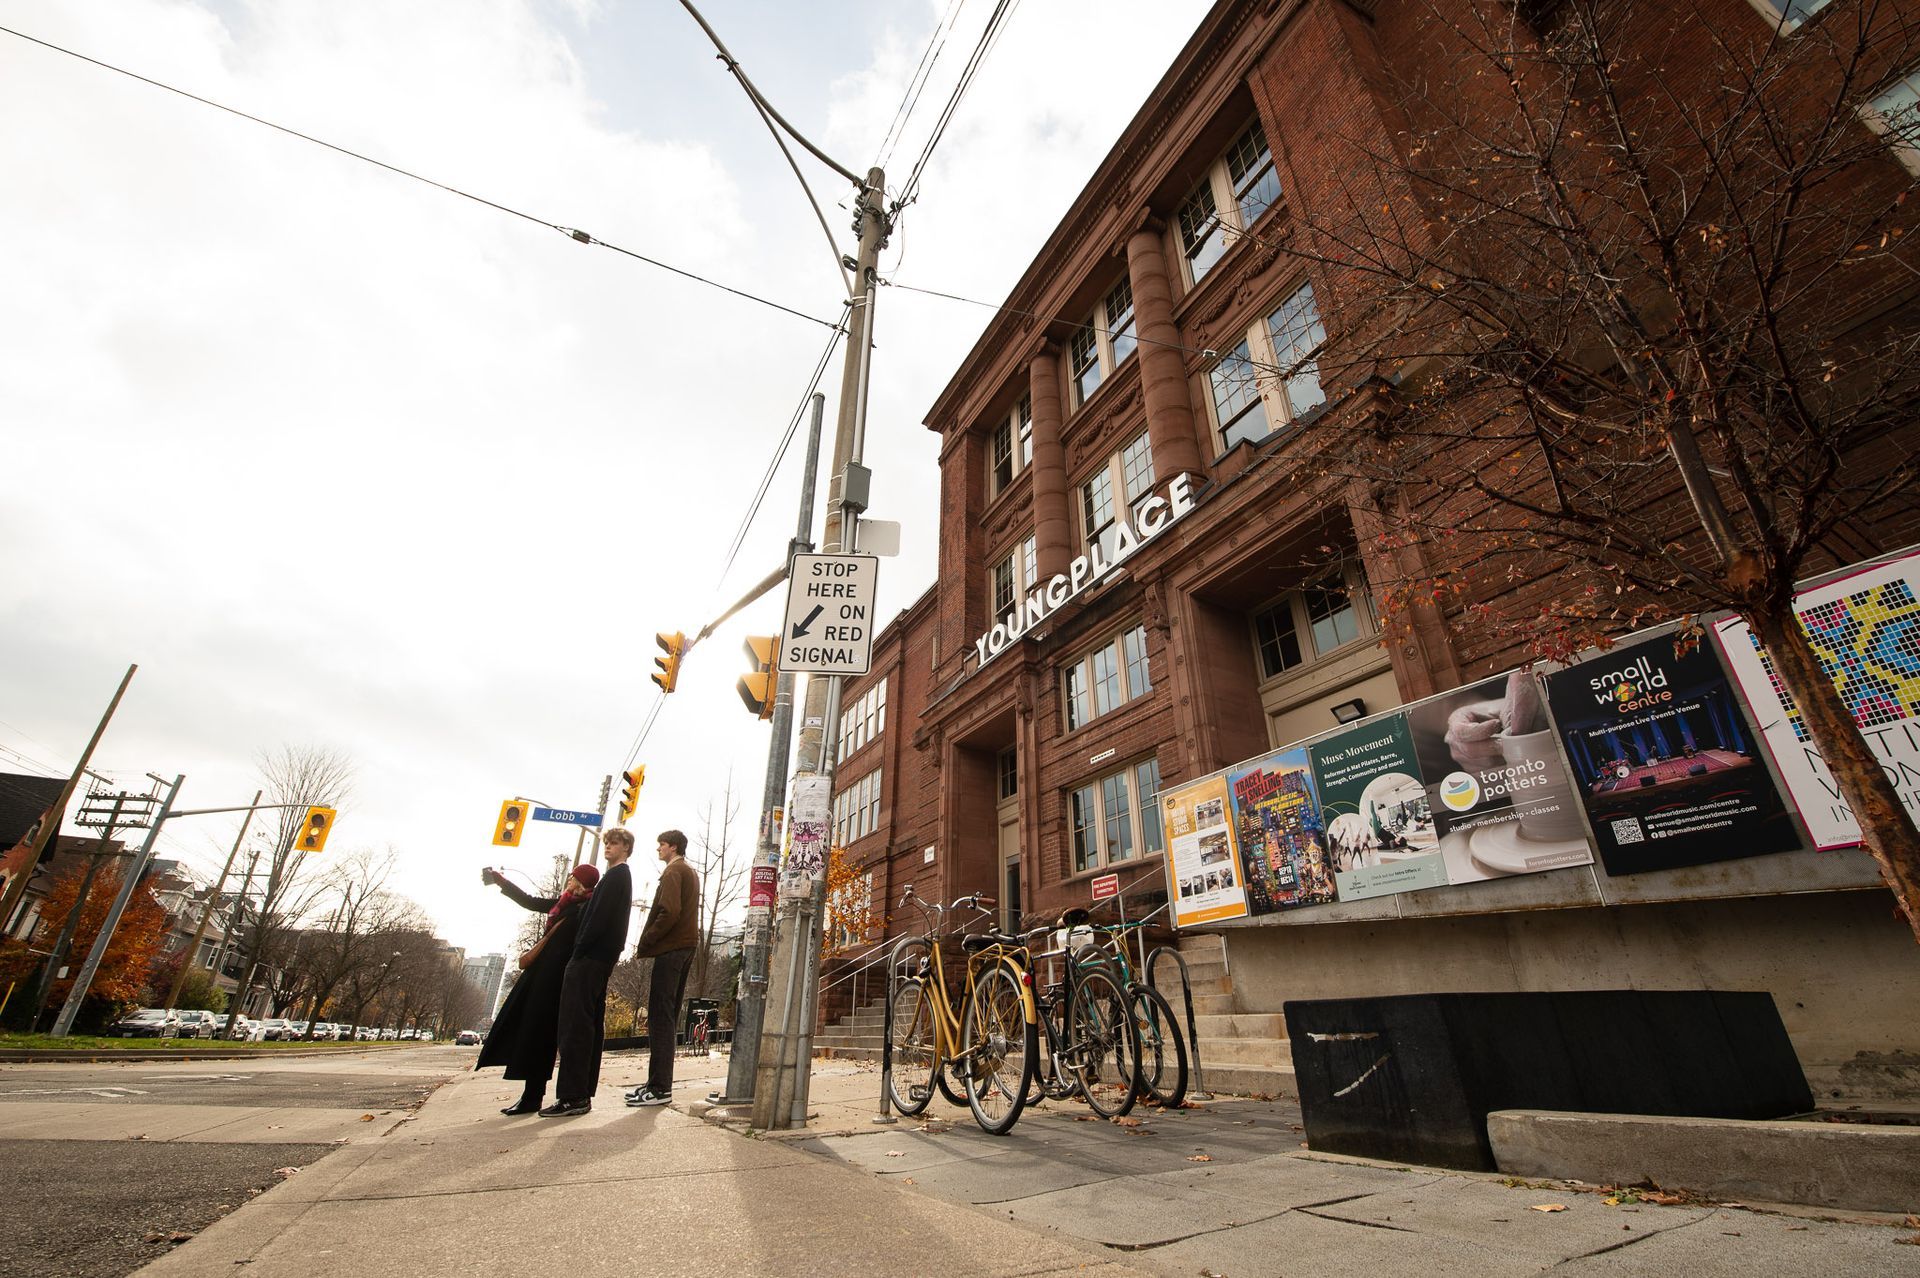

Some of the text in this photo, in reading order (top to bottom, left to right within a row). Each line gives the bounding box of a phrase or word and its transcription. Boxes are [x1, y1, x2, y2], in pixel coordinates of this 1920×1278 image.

[812, 562, 858, 577] STOP
[976, 472, 1196, 667] YOUNGPLACE
[807, 583, 857, 598] HERE
[840, 605, 865, 620] ON
[825, 626, 863, 641] RED
[789, 647, 853, 664] SIGNAL
[1590, 656, 1651, 690] small
[1618, 690, 1673, 713] centre
[1589, 703, 1700, 738] Multi-purpose Live Events Venue
[1321, 734, 1394, 767] Muse Movement
[1324, 768, 1346, 779] Reformer
[1348, 767, 1377, 781] Community
[1377, 763, 1388, 771] and
[1388, 758, 1405, 768] more!
[1480, 759, 1546, 784] toronto
[1236, 771, 1261, 795] TRACEY
[1248, 774, 1280, 801] SNELLING
[1483, 774, 1548, 801] potters
[549, 810, 575, 821] Lobb
[1449, 804, 1560, 833] studio membership classes
[1644, 799, 1740, 821] smallworldmusic.com/centre
[1655, 805, 1757, 828] venue@smallworldmusic.com
[1666, 820, 1733, 836] @smallworldcentre
